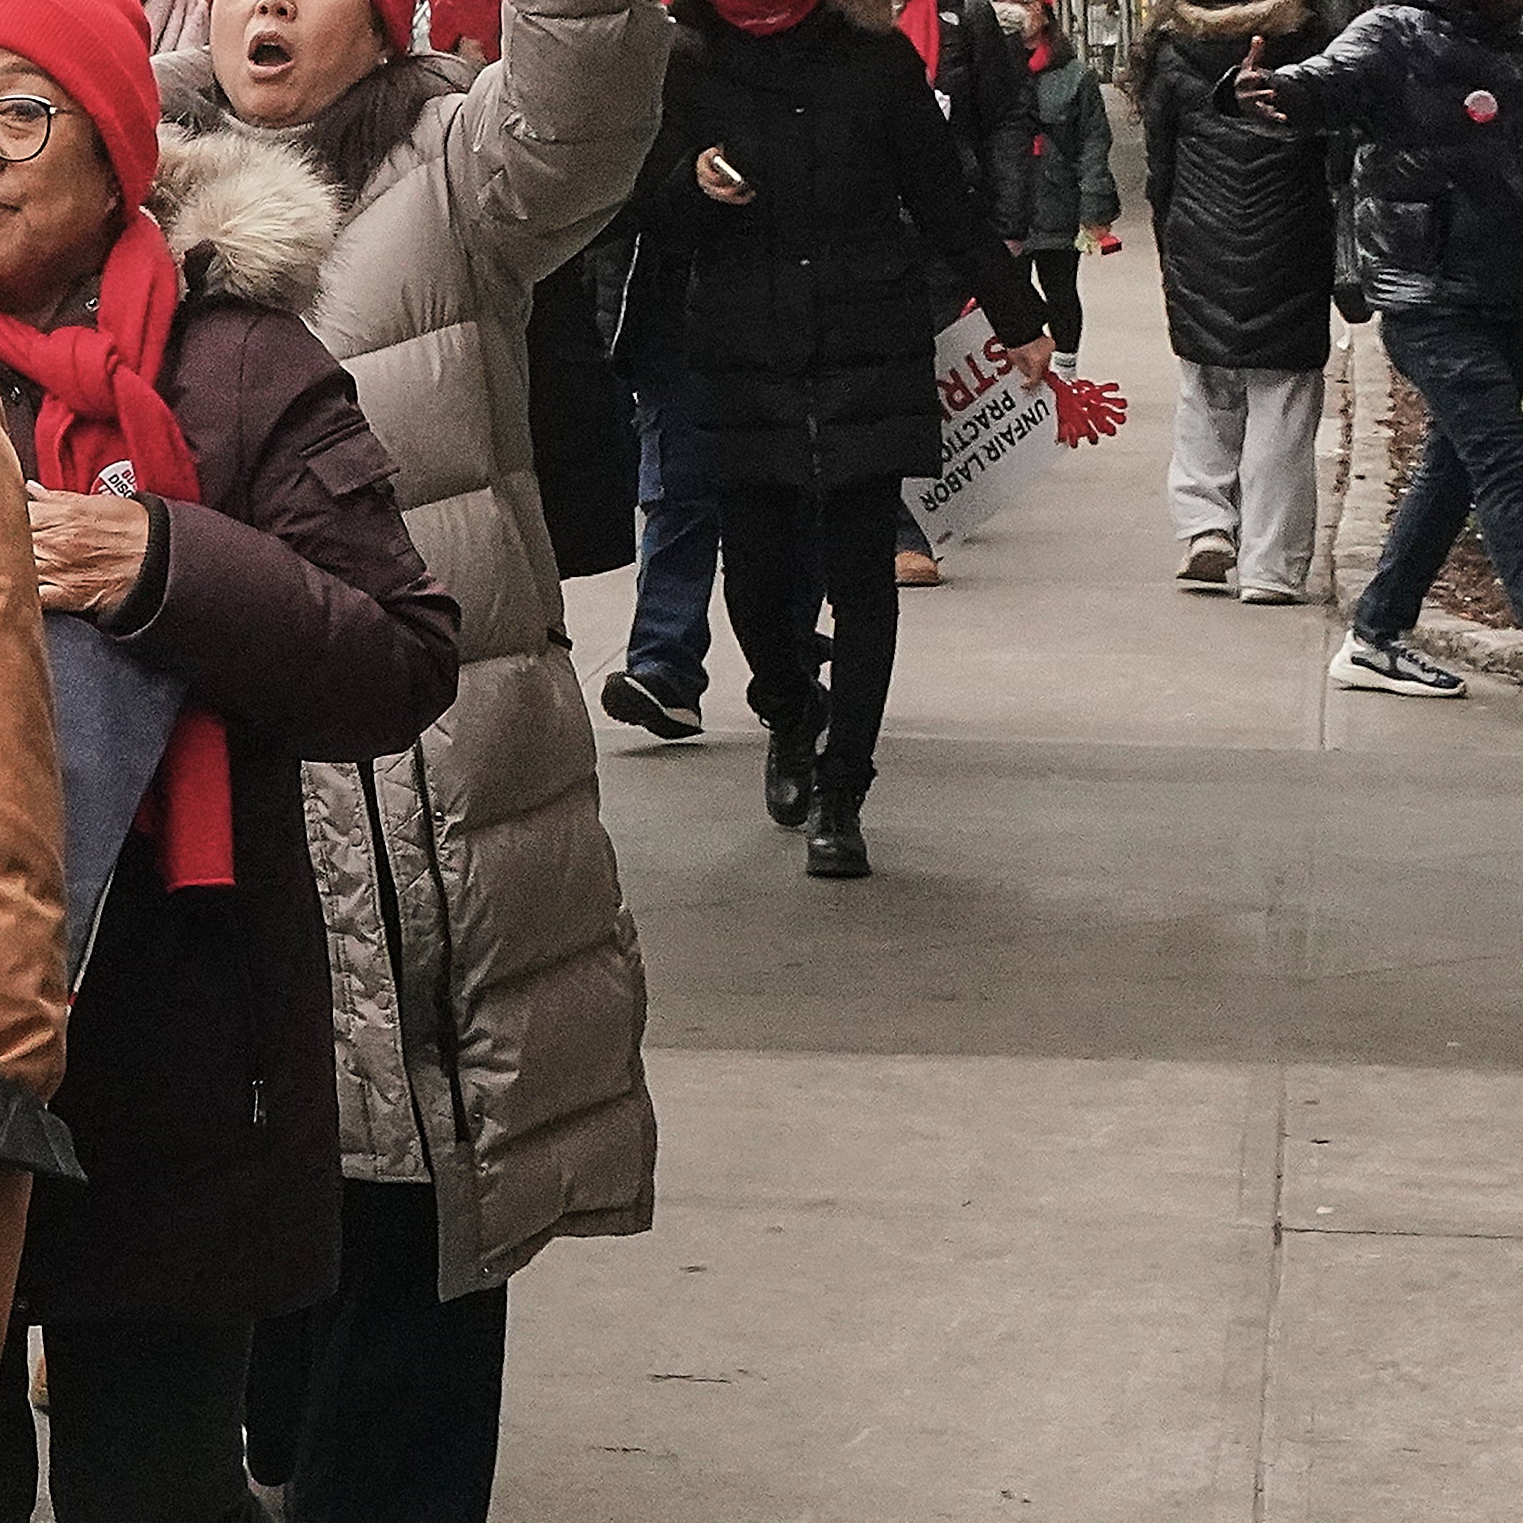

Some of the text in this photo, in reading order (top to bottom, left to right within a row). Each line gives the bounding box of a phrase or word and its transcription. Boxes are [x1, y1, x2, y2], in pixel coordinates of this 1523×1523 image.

[936, 335, 1013, 423] STR
[919, 398, 1051, 512] UNFAIR LABOR
